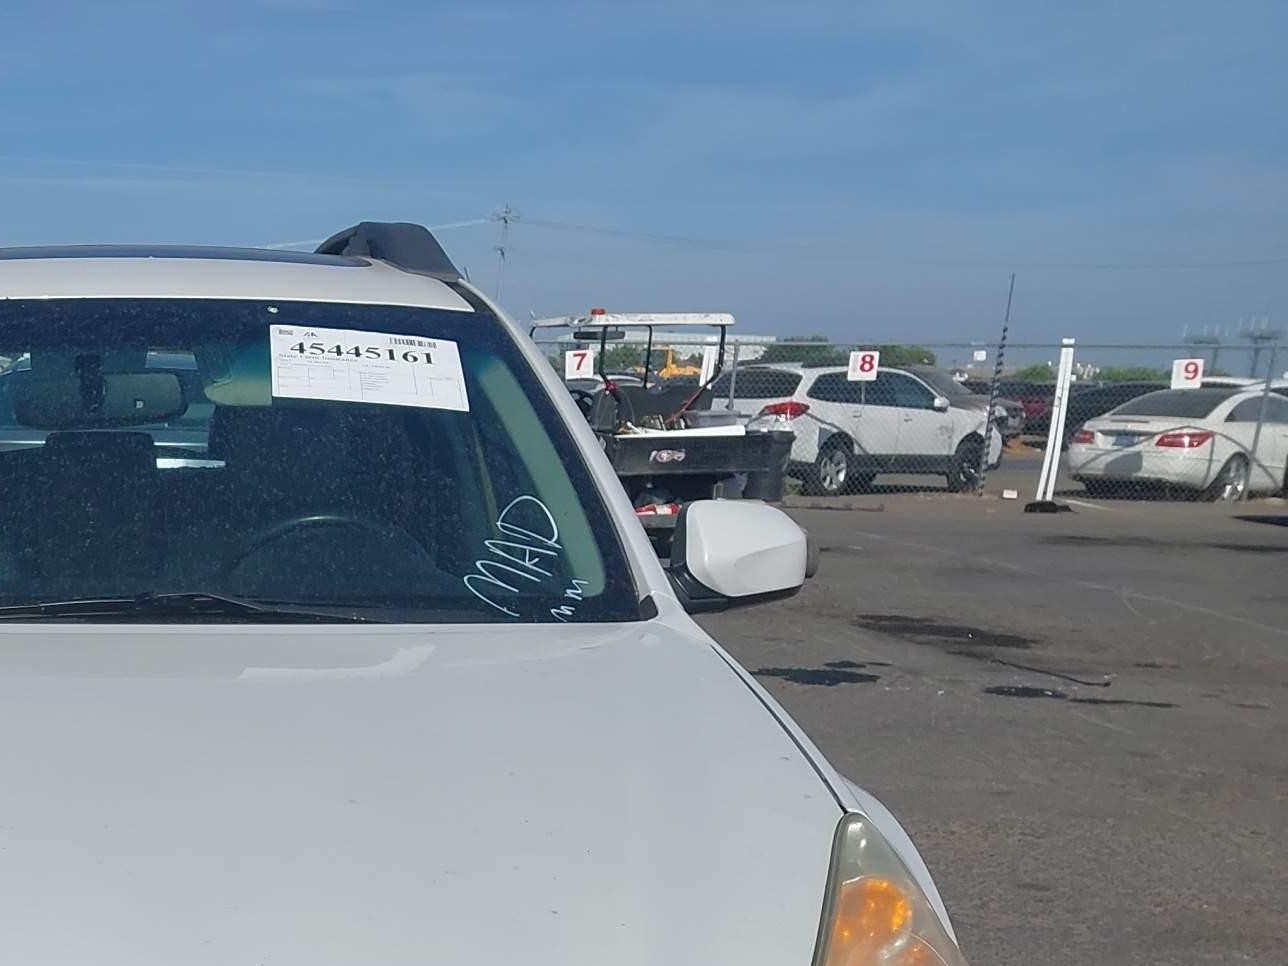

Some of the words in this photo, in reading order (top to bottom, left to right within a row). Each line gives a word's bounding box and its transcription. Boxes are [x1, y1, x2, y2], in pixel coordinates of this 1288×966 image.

[290, 341, 434, 365] 45445161
[573, 352, 588, 371] 7
[859, 354, 875, 372] 8
[1184, 361, 1199, 380] 9
[463, 495, 563, 617] MAD
